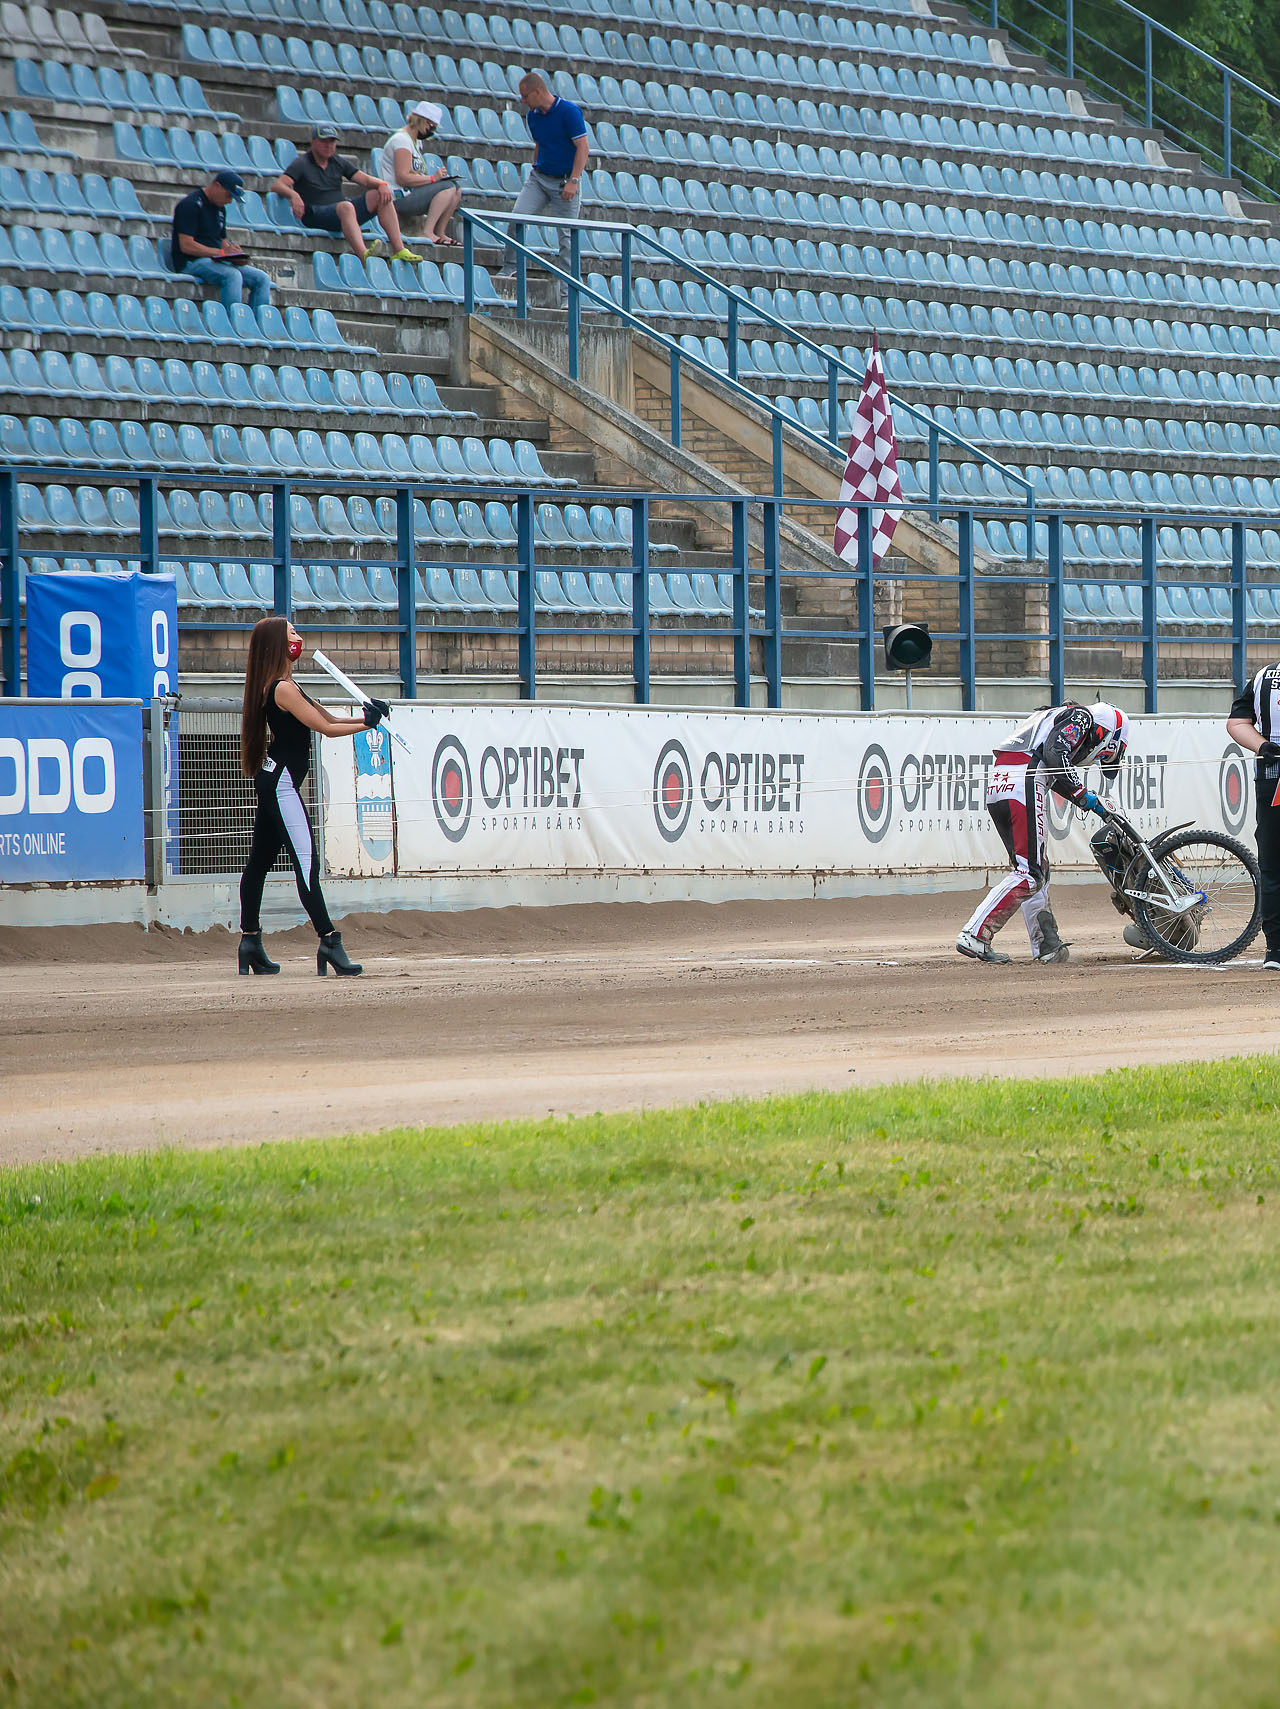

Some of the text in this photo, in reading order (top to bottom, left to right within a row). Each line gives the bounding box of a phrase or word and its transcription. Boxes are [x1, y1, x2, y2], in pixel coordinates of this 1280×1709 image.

[480, 745, 584, 809] OPTIBET
[700, 752, 804, 812] OPTIBET
[900, 754, 993, 812] OPTIBET
[482, 817, 537, 831] SPORTA
[700, 818, 759, 834] SPORTA
[900, 818, 952, 832] SPORTA
[1035, 784, 1044, 836] LATVIA
[24, 833, 66, 855] ONLINE
